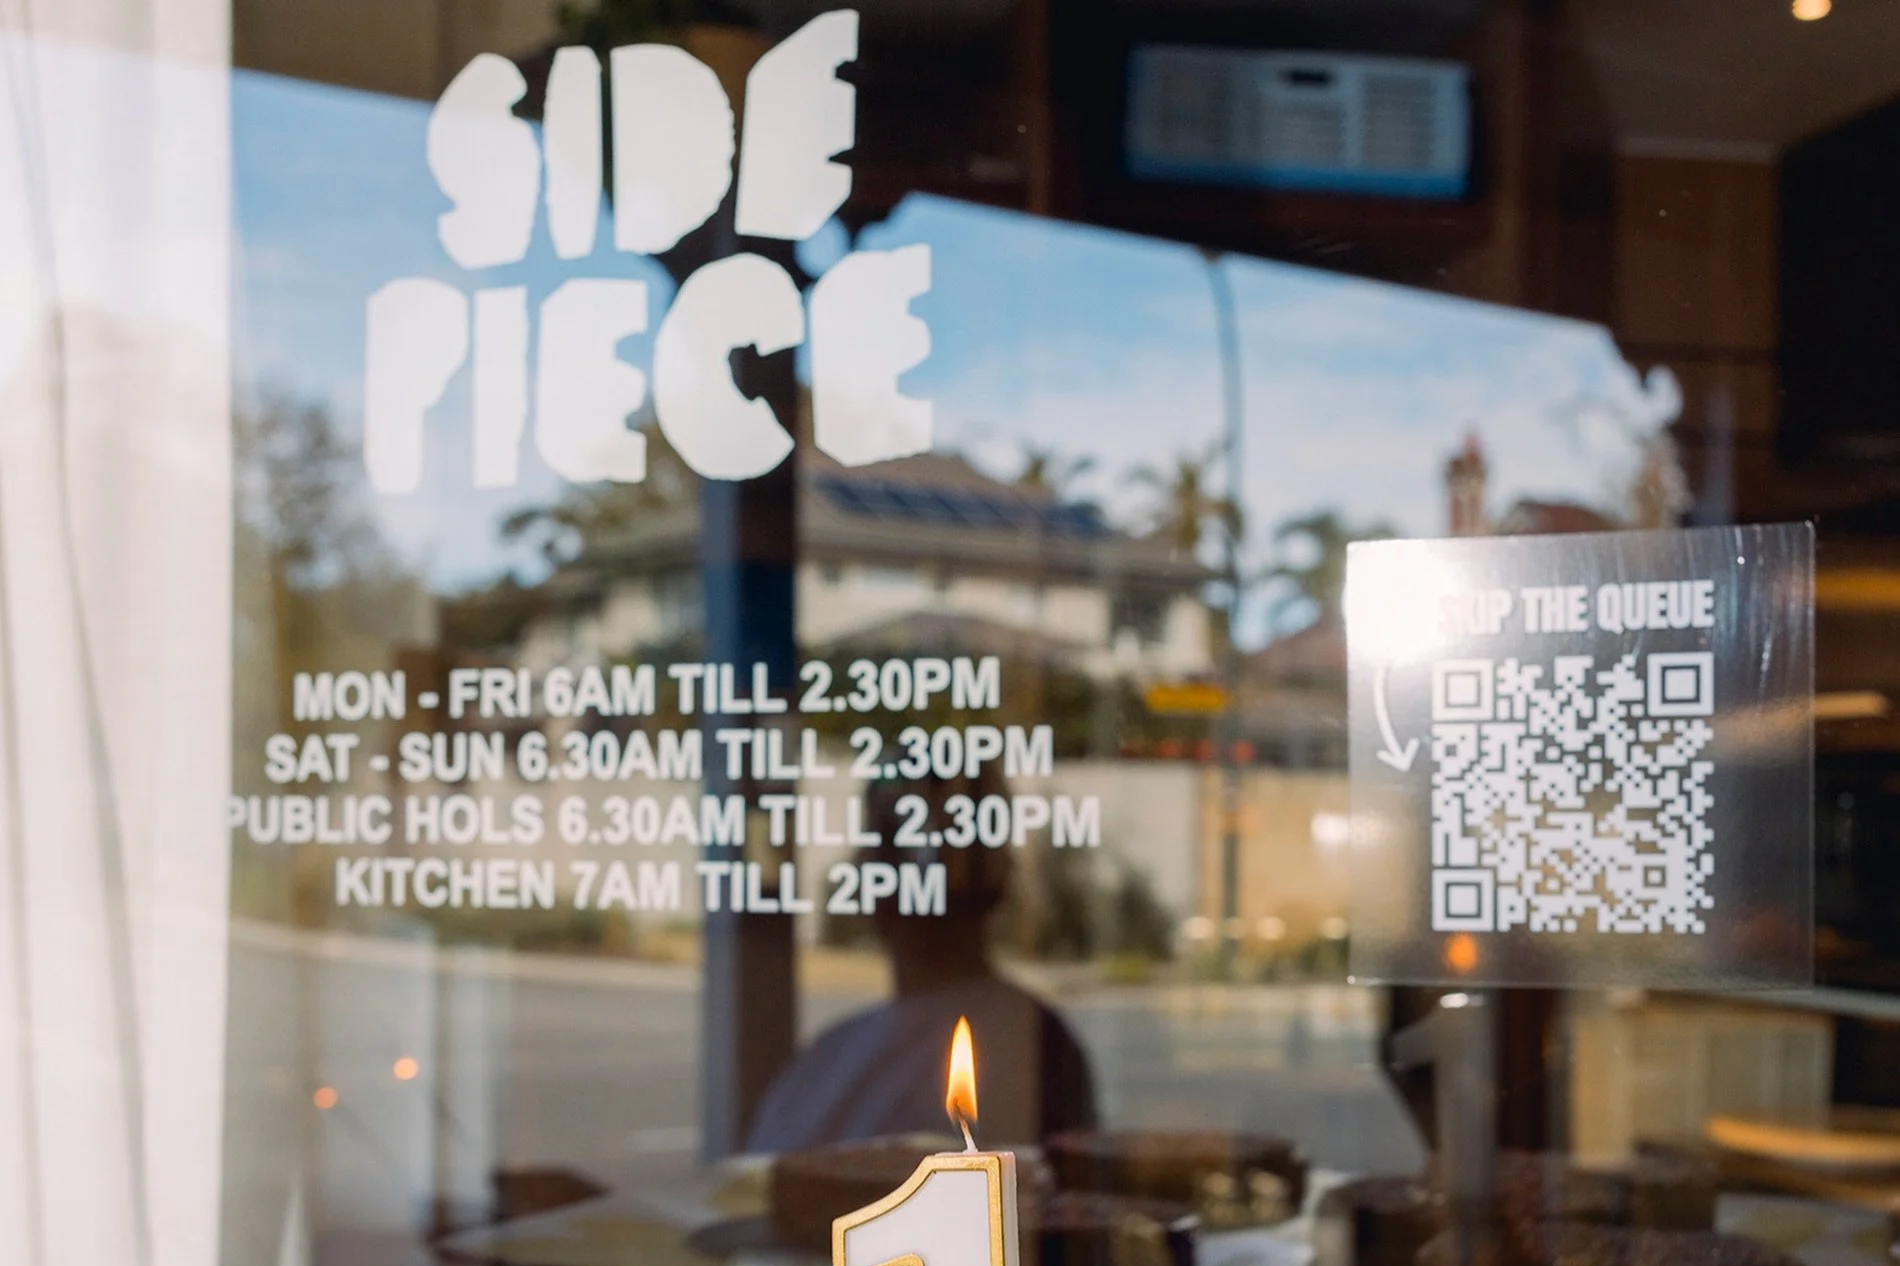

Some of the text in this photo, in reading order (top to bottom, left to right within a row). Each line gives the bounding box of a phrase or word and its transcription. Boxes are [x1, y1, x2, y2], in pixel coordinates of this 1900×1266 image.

[426, 8, 859, 270] SIDE
[363, 244, 933, 494] PIECE
[1439, 579, 1716, 635] IP THE QUEUE
[293, 671, 406, 721] MON
[448, 667, 532, 718] FRI
[543, 664, 656, 716] 6AM
[667, 661, 788, 715] TILL
[798, 656, 1000, 714] 2.30PM
[264, 732, 360, 783] SAT
[398, 731, 505, 783] SUN
[517, 729, 702, 782] 6.30AM
[715, 727, 836, 780] TILL
[849, 724, 1053, 780] 2.30PM
[224, 794, 1101, 848] PUBLIC HOLS 6.30AM TILL 2.30PM
[335, 857, 948, 916] KITCHEN 7AM TILL 2PM
